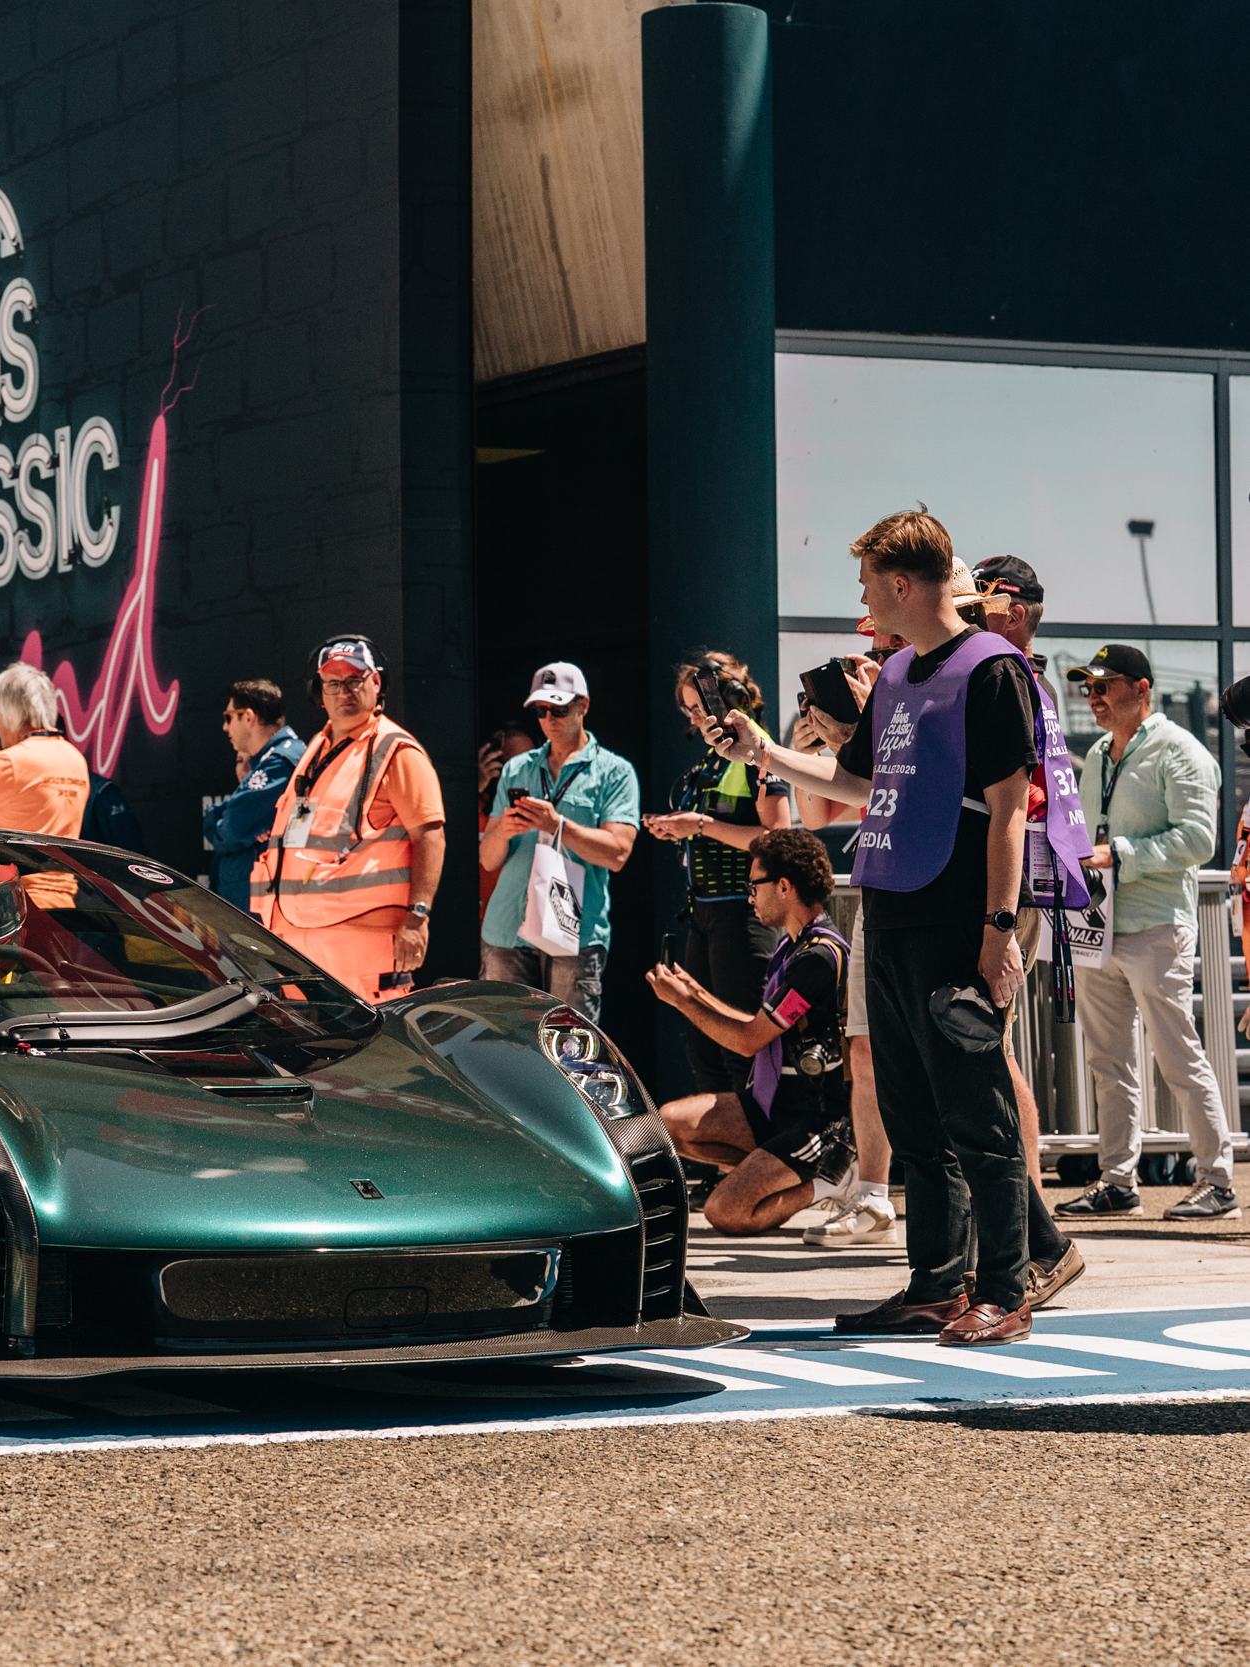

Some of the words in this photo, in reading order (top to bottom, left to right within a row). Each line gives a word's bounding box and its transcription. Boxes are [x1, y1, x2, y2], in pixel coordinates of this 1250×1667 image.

[895, 702, 905, 713] LE
[890, 712, 910, 724] MANS
[895, 765, 917, 775] 2026
